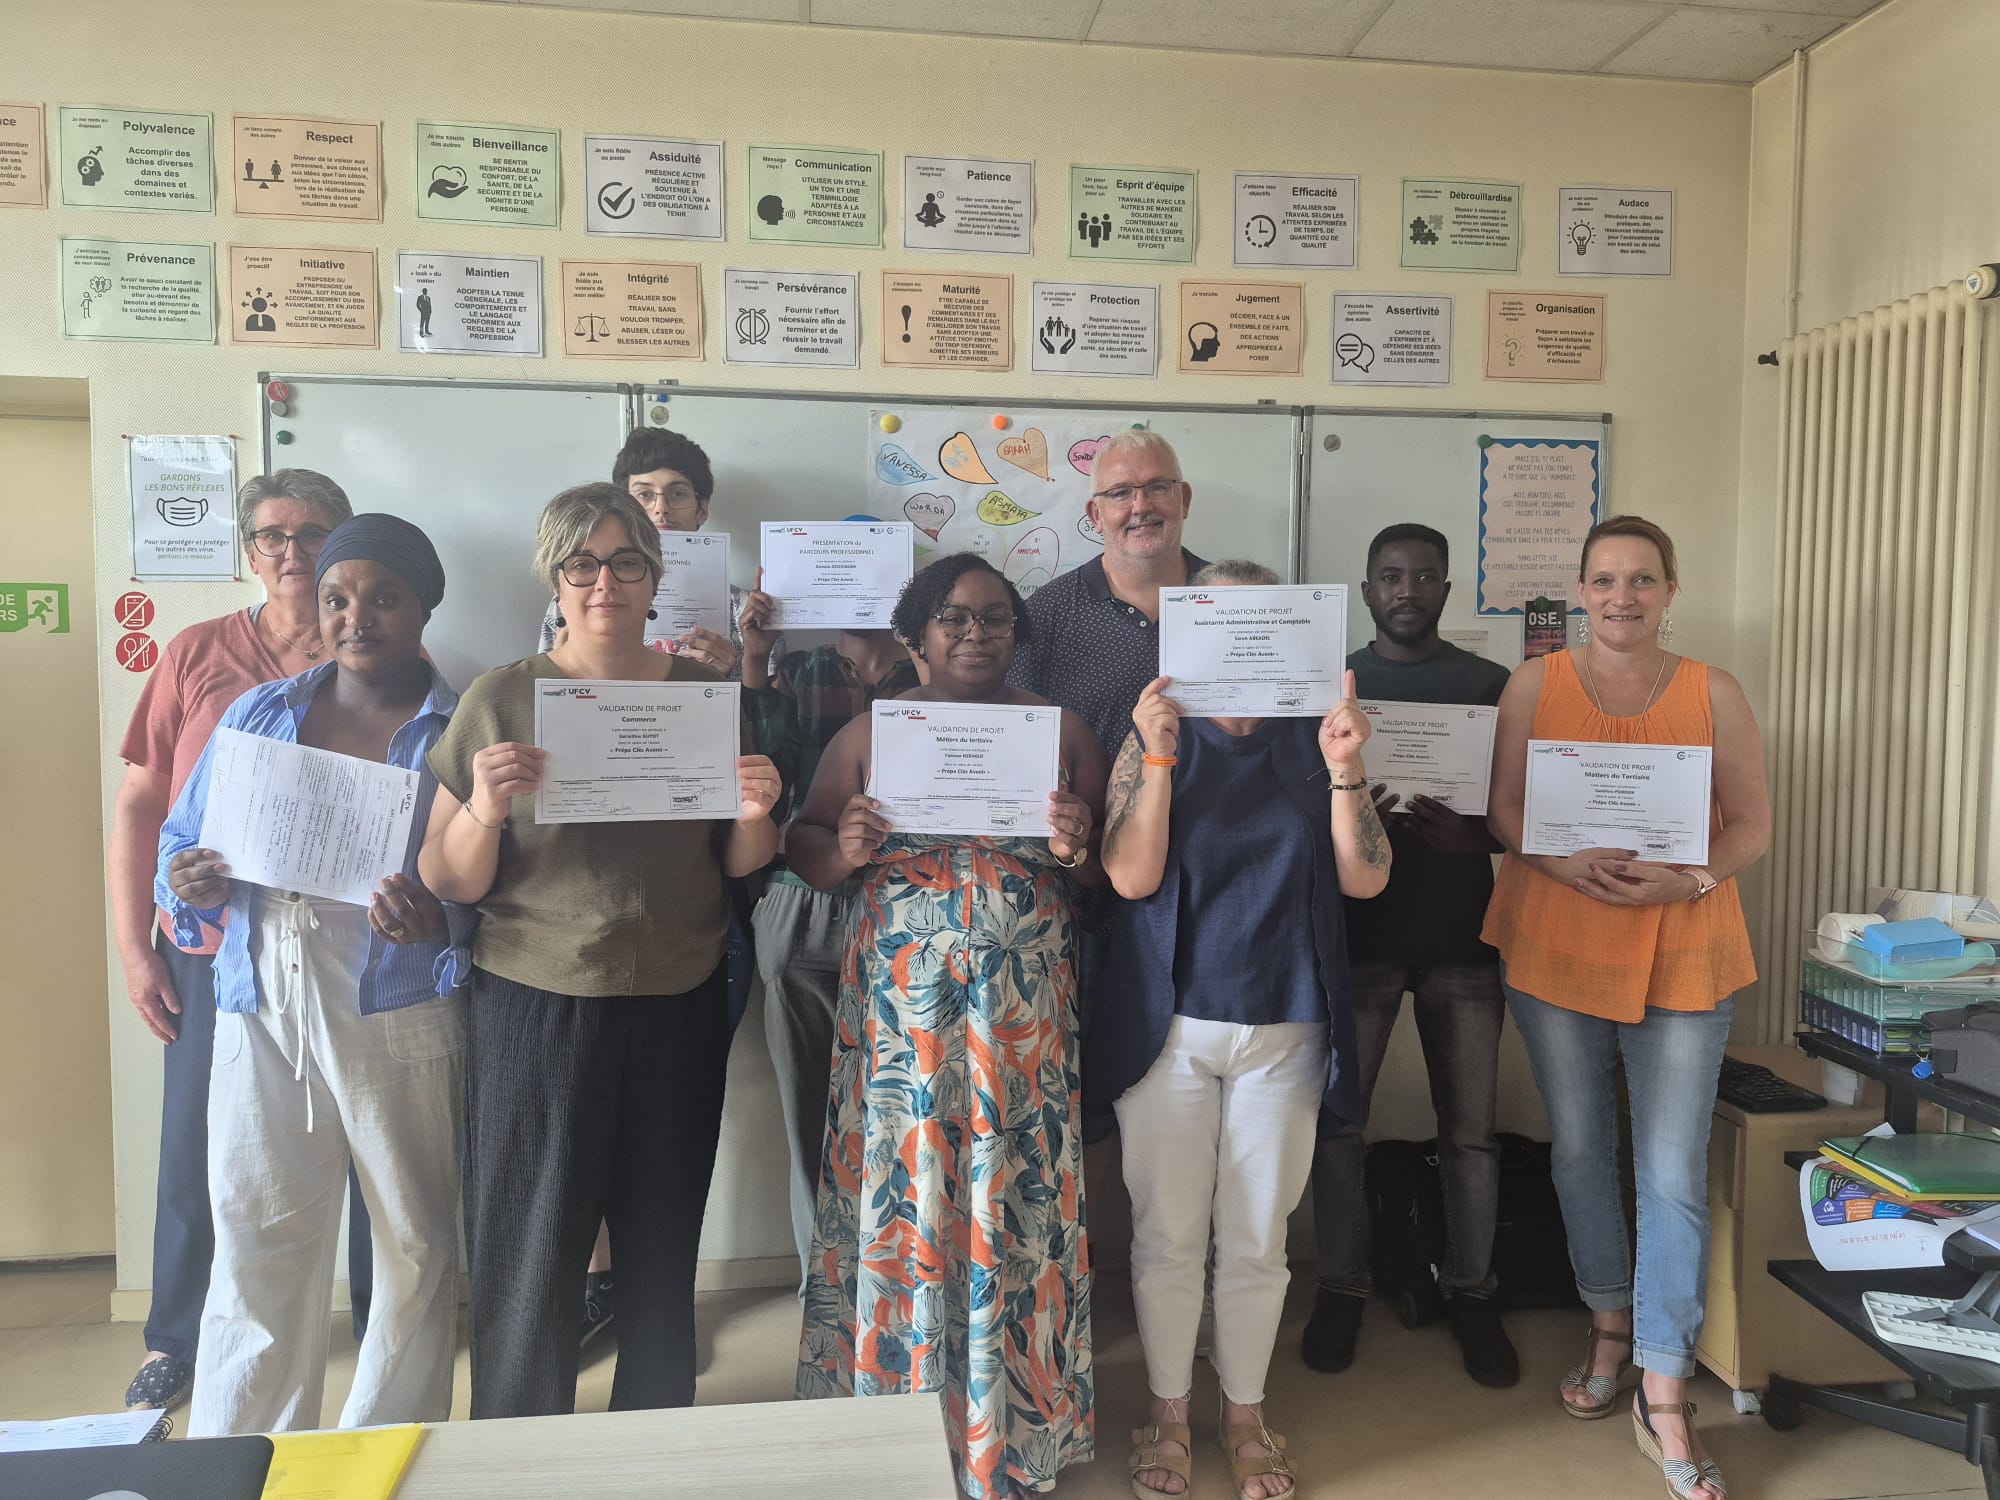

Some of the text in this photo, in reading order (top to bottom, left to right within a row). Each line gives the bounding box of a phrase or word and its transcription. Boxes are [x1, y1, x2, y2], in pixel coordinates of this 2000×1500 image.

[123, 121, 195, 135] Polyvalence
[307, 131, 353, 144] Respect
[473, 138, 548, 152] Bienveillance
[129, 147, 190, 157] Accomplir des
[126, 158, 193, 167] tâches diverses
[650, 151, 701, 164] Assiduité
[480, 165, 530, 173] RESPONSABLE
[795, 159, 872, 172] Communication
[141, 169, 161, 177] dans
[482, 173, 516, 181] CONFORT,
[967, 170, 1011, 181] Patience
[134, 179, 176, 187] domaines
[1117, 180, 1184, 193] Esprit d'équipe
[125, 189, 197, 200] contextes variés.
[1292, 187, 1337, 197] Efficacité
[1450, 191, 1512, 202] Débrouillardise
[491, 206, 530, 214] PERSONNE.
[658, 202, 702, 210] OBLIGATIONS
[804, 210, 841, 218] PERSONNE
[807, 219, 863, 227] CIRCONSTANCES
[127, 253, 195, 264] Prévenance
[300, 259, 345, 270] Initiative
[465, 267, 509, 278] Maintien
[628, 274, 669, 284] Intégrité
[777, 282, 847, 294] Persévérance
[943, 285, 980, 295] Maturité
[1090, 294, 1140, 305] Protection
[1236, 294, 1280, 304] Jugement
[786, 306, 812, 314] Fournir
[1386, 306, 1440, 316] Assertivité
[1536, 304, 1595, 315] Organisation
[779, 316, 819, 324] nécessaire
[794, 346, 830, 354] demandé.
[882, 452, 927, 481] VANESSA
[187, 483, 224, 492] RÉFLEXES
[1529, 612, 1561, 625] OSE.
[928, 725, 968, 733] VALIDATION
